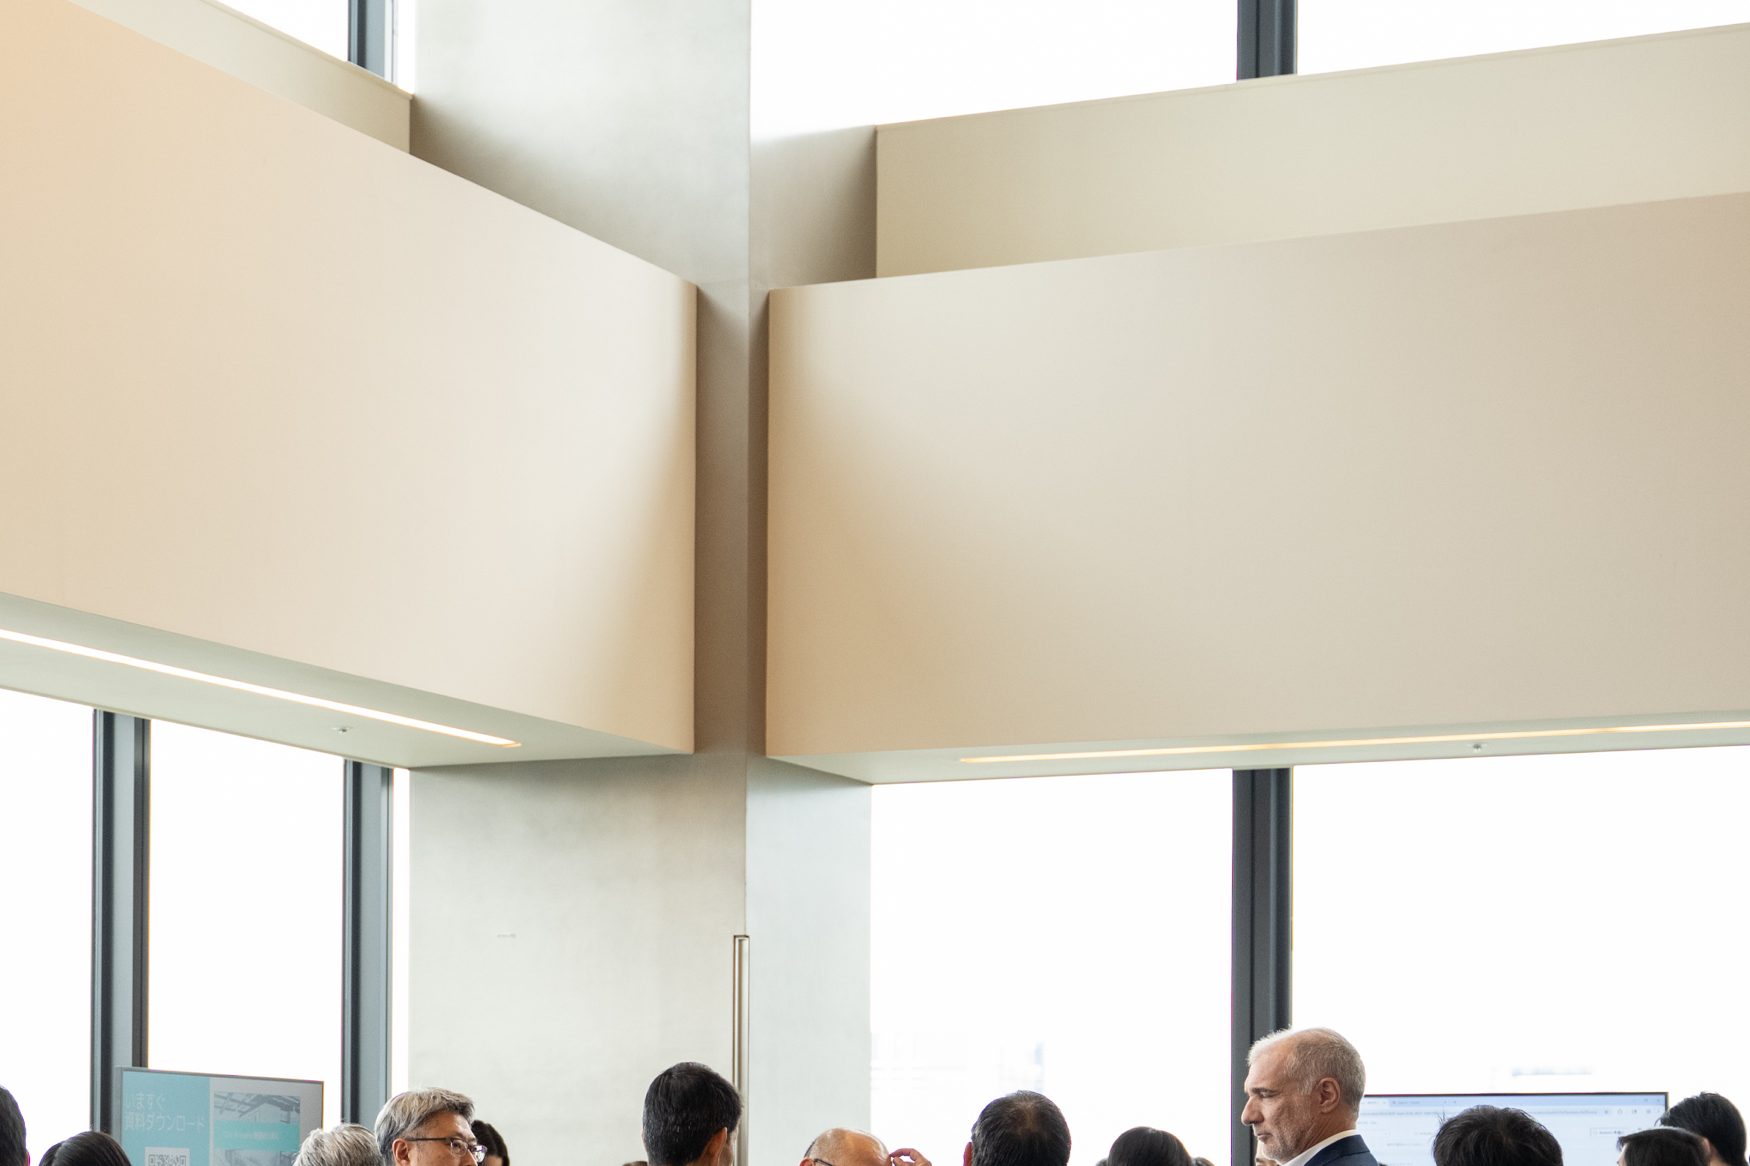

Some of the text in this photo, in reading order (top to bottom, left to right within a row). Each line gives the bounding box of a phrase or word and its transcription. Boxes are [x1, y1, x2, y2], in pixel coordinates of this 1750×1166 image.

[125, 1092, 165, 1111] いますぐ
[125, 1111, 205, 1133] 資料ダウンロード
